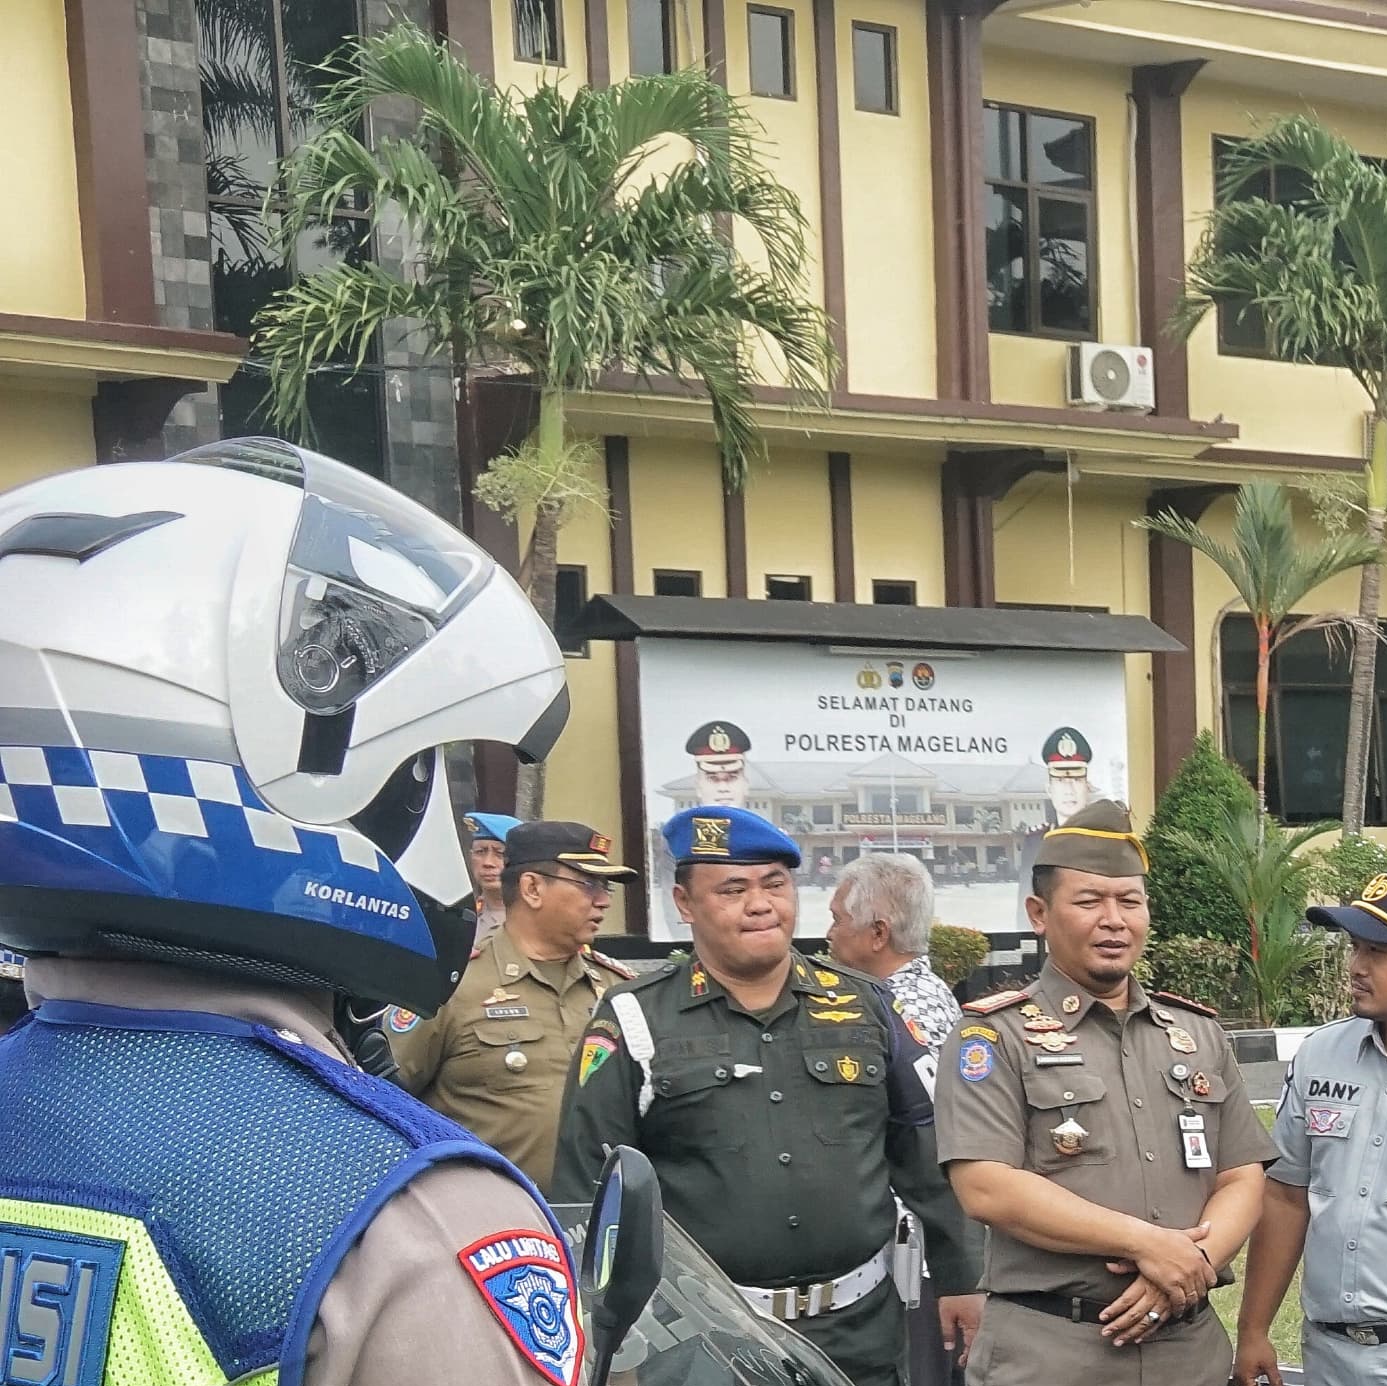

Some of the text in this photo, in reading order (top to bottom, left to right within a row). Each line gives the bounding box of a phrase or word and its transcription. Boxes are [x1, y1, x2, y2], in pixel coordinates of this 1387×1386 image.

[817, 695, 974, 713] SELAMAT DATANG
[890, 714, 906, 728] DI
[784, 734, 1008, 753] POLRESTA MAGELANG
[303, 881, 411, 920] KORLANTAS
[1308, 1079, 1360, 1100] DANY
[468, 1237, 561, 1272] LALU LINTAS
